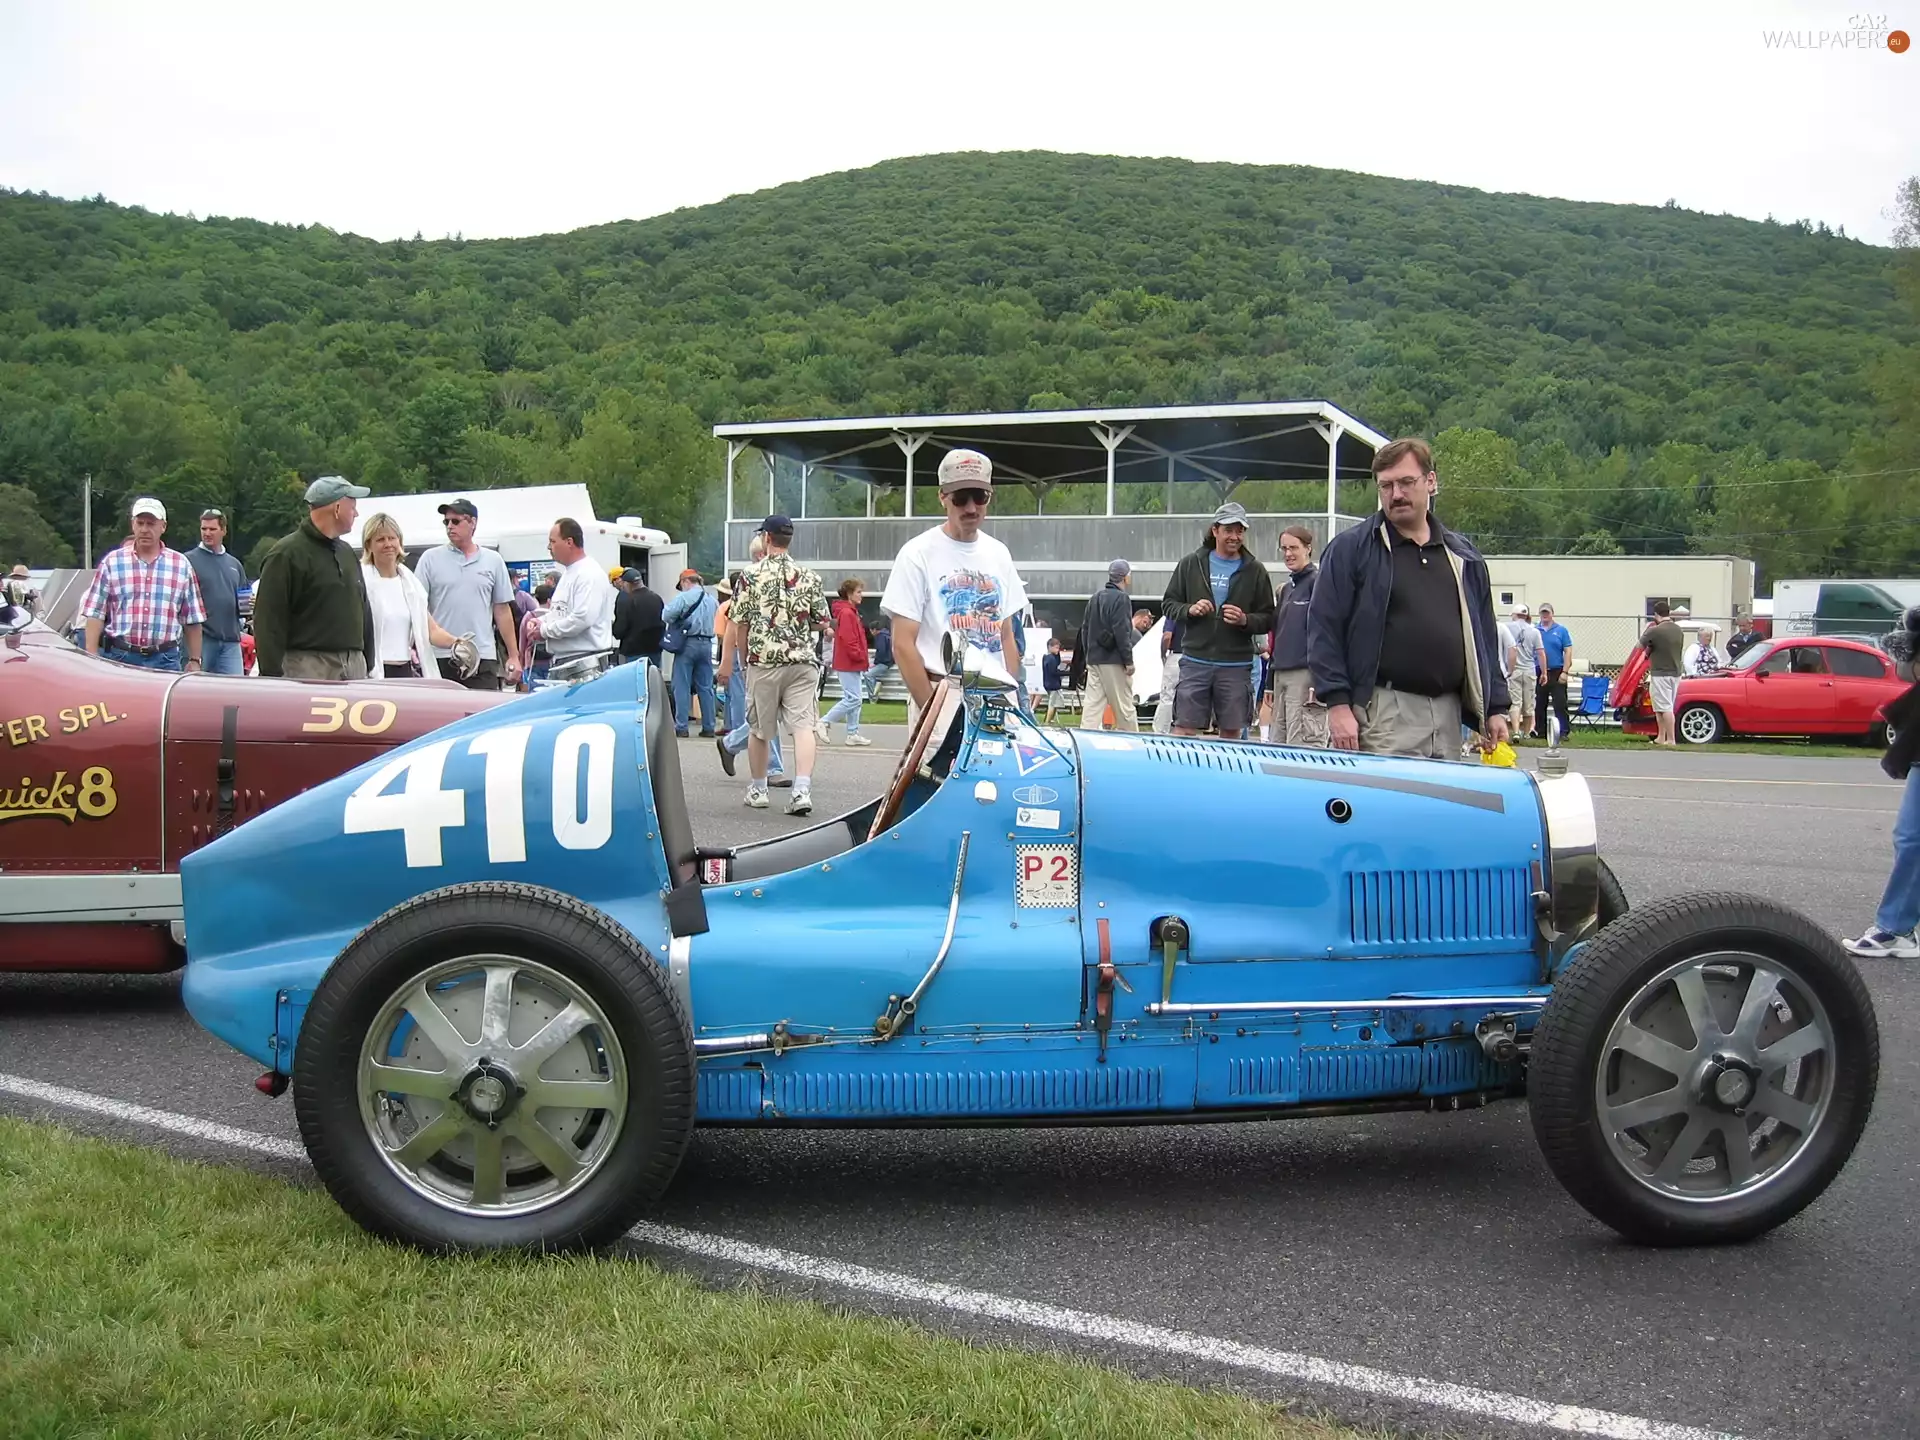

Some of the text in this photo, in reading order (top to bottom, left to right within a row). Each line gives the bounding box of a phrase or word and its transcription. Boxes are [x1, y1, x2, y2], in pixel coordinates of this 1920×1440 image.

[59, 701, 128, 733] SPL.
[301, 697, 398, 735] 30
[343, 723, 617, 868] 410
